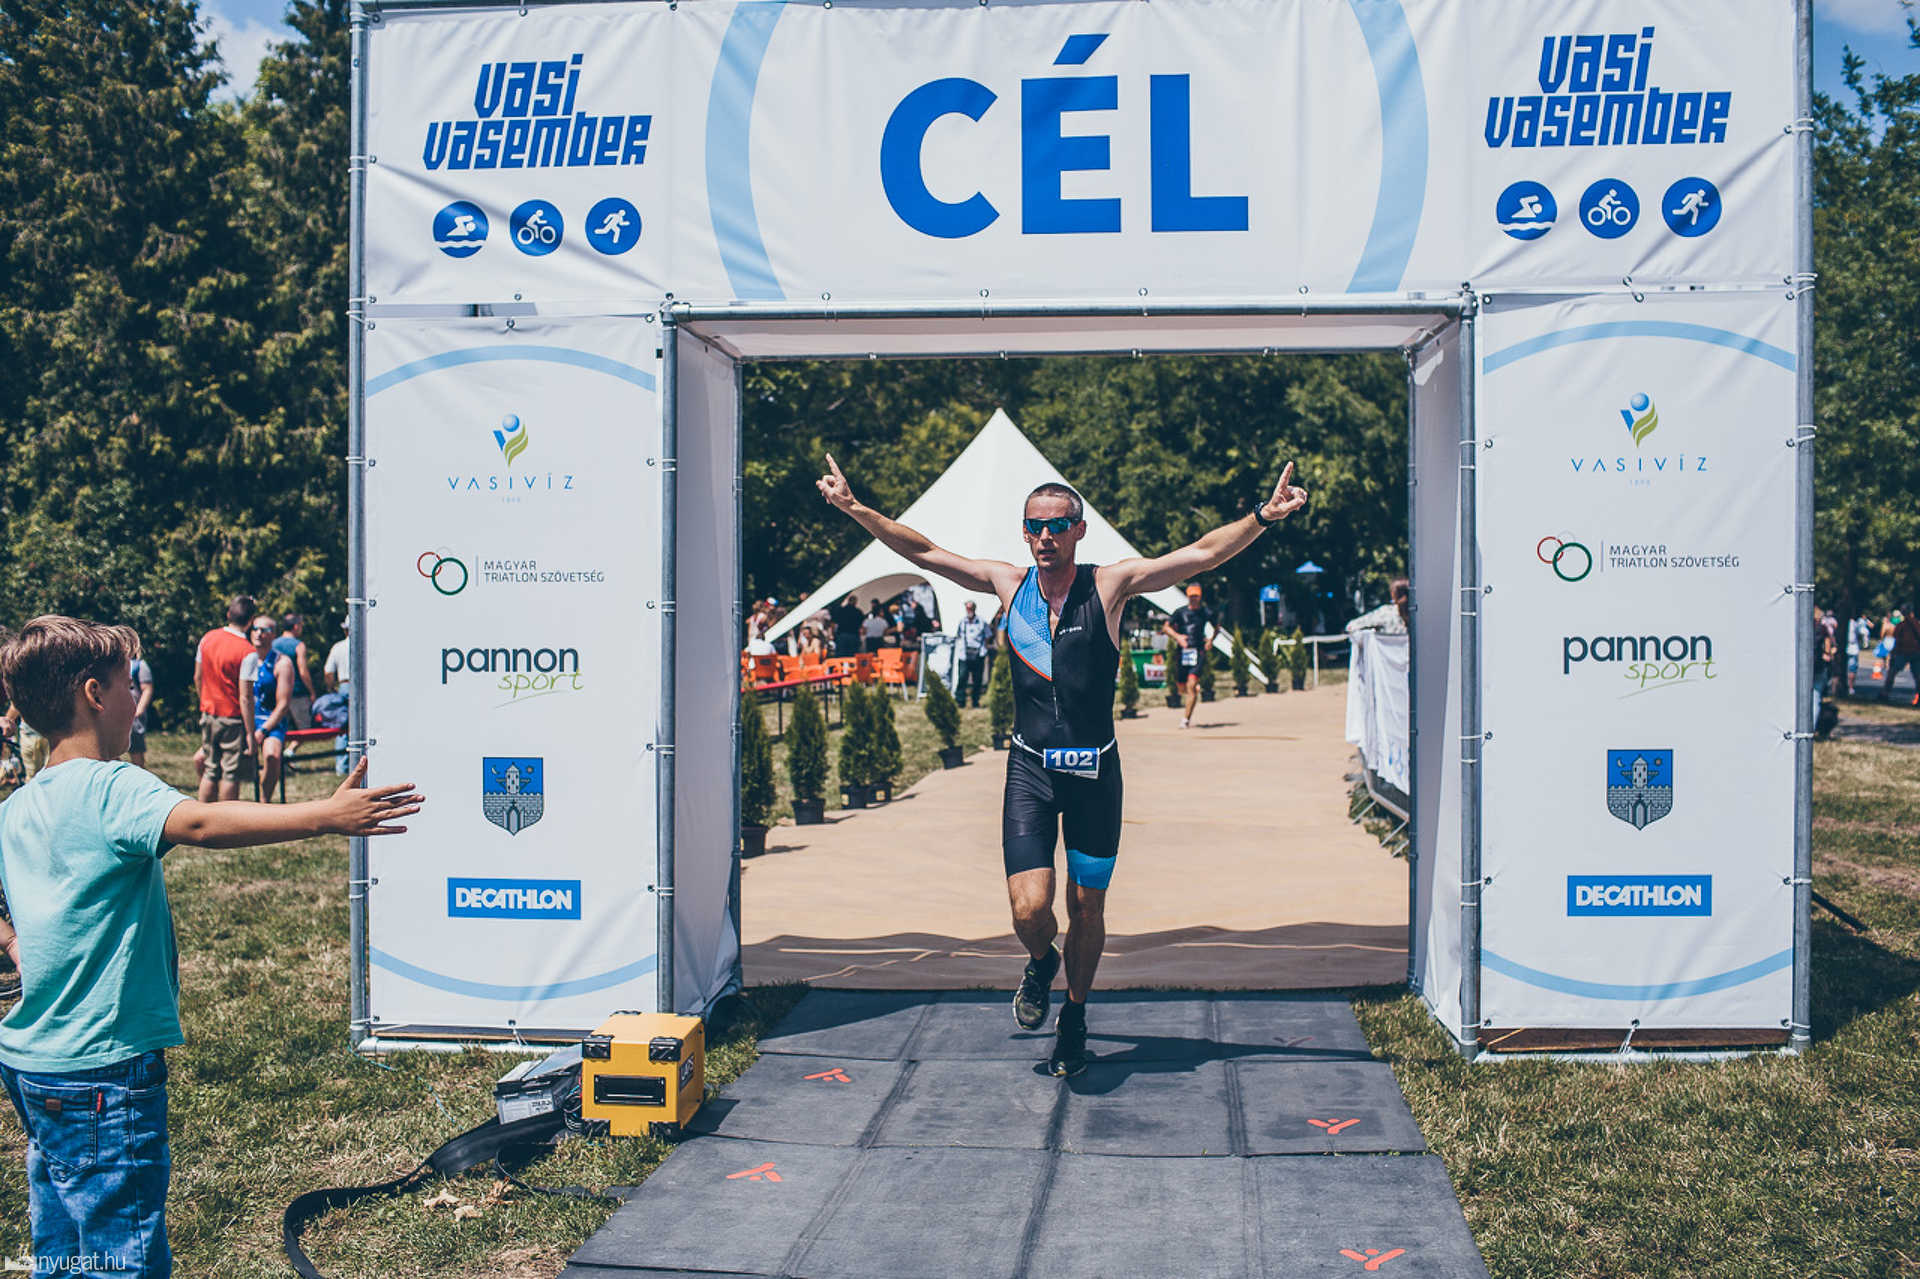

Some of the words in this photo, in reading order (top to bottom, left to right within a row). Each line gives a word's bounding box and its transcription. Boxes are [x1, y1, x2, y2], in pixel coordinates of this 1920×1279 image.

[880, 34, 1249, 239] CÉL
[1609, 545, 1667, 555] MAGYAR
[1610, 557, 1668, 568] TRIATLON
[1670, 553, 1740, 568] SZÖVETSÉG
[484, 560, 536, 570] MAGYAR
[484, 572, 538, 583] TRIATLON
[541, 569, 605, 583] SZÖVETSÉG
[1563, 635, 1712, 674] pannon
[441, 648, 579, 685] pannon
[1623, 657, 1717, 688] sport
[497, 669, 584, 698] sport
[1051, 750, 1093, 767] 102
[455, 887, 573, 911] DECATHLON
[1576, 884, 1702, 907] DECATHLON
